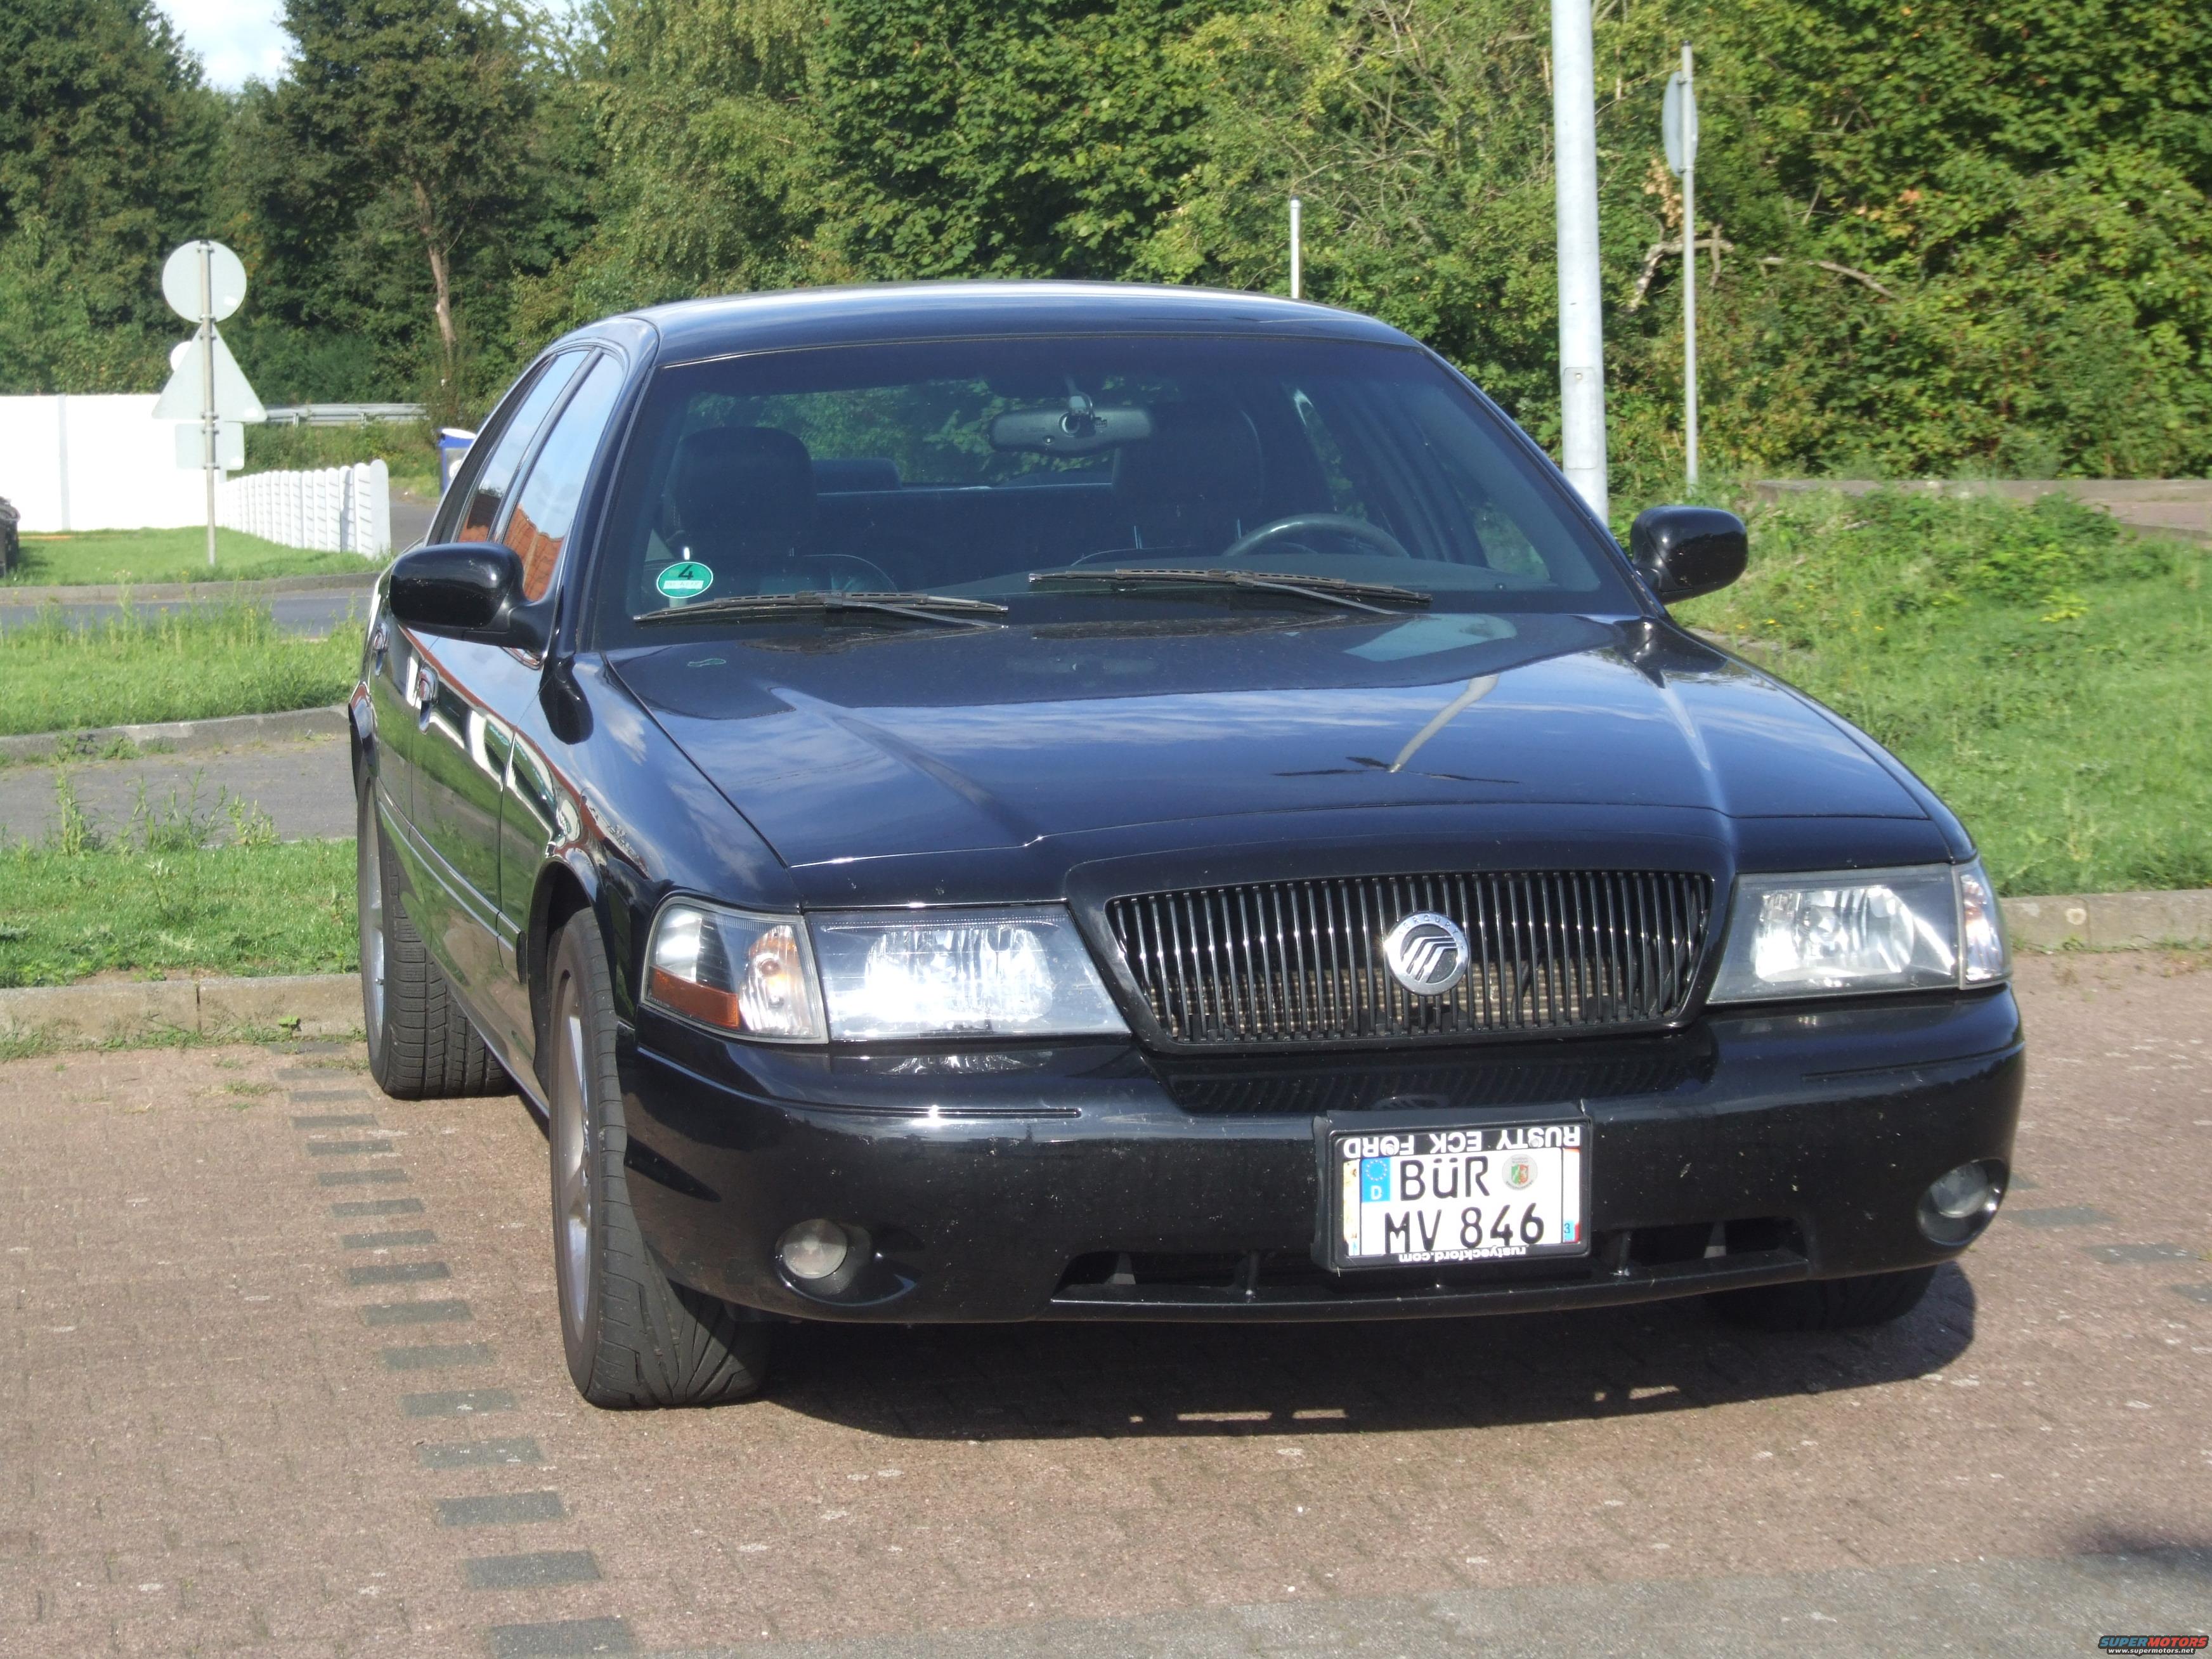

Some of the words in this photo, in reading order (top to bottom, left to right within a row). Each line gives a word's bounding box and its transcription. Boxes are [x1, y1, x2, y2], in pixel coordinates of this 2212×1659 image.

[678, 564, 694, 580] 4
[1343, 1135, 1415, 1159] FORD
[1429, 1131, 1482, 1154] ECK
[1496, 1126, 1580, 1150] RUSTY
[1400, 1155, 1490, 1202] BÜR
[1370, 1185, 1382, 1200] D
[1384, 1209, 1442, 1253] MV
[1459, 1203, 1544, 1248] 846
[1398, 1246, 1526, 1263] rustyeckford.com
